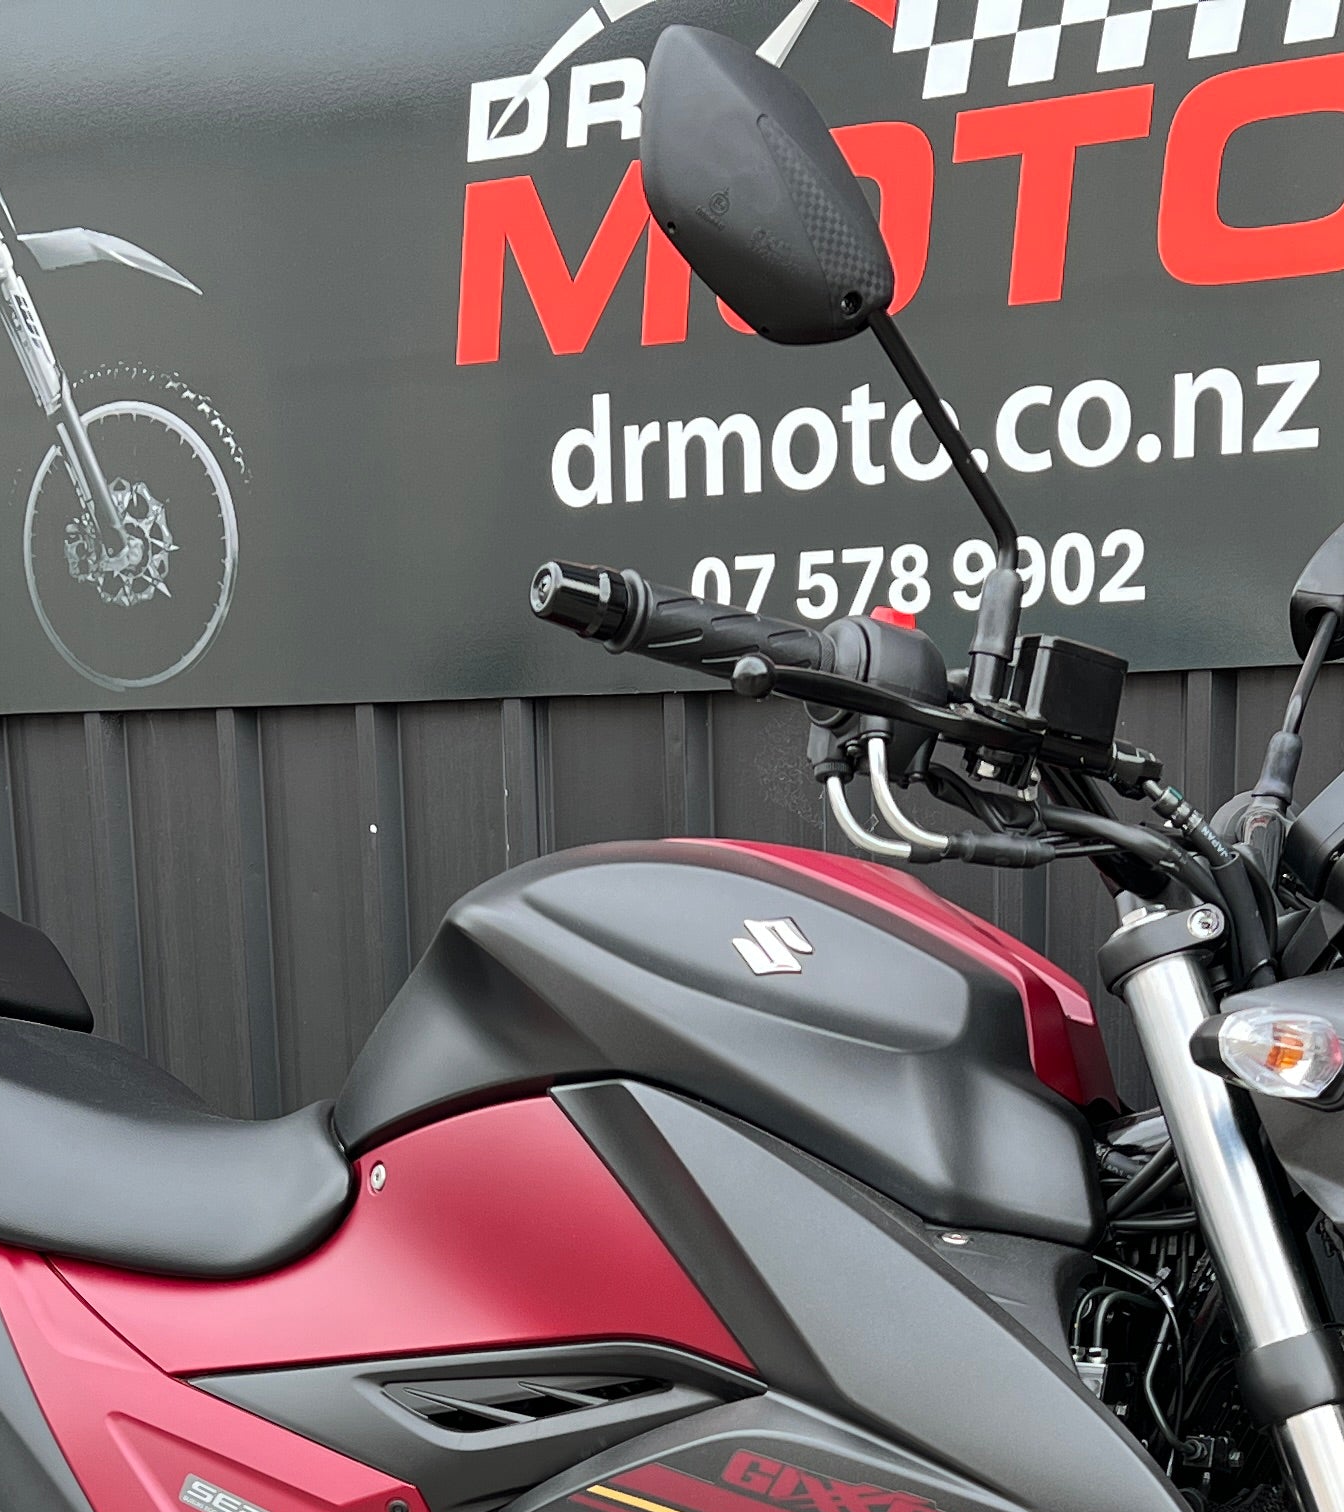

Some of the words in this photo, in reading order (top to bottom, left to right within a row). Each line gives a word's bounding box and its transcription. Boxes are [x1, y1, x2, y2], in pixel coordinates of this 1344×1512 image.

[550, 361, 1320, 507] drmoto.co.nz
[795, 543, 931, 620] 578
[953, 528, 1146, 611] 9902
[1201, 825, 1229, 857] JAPAN
